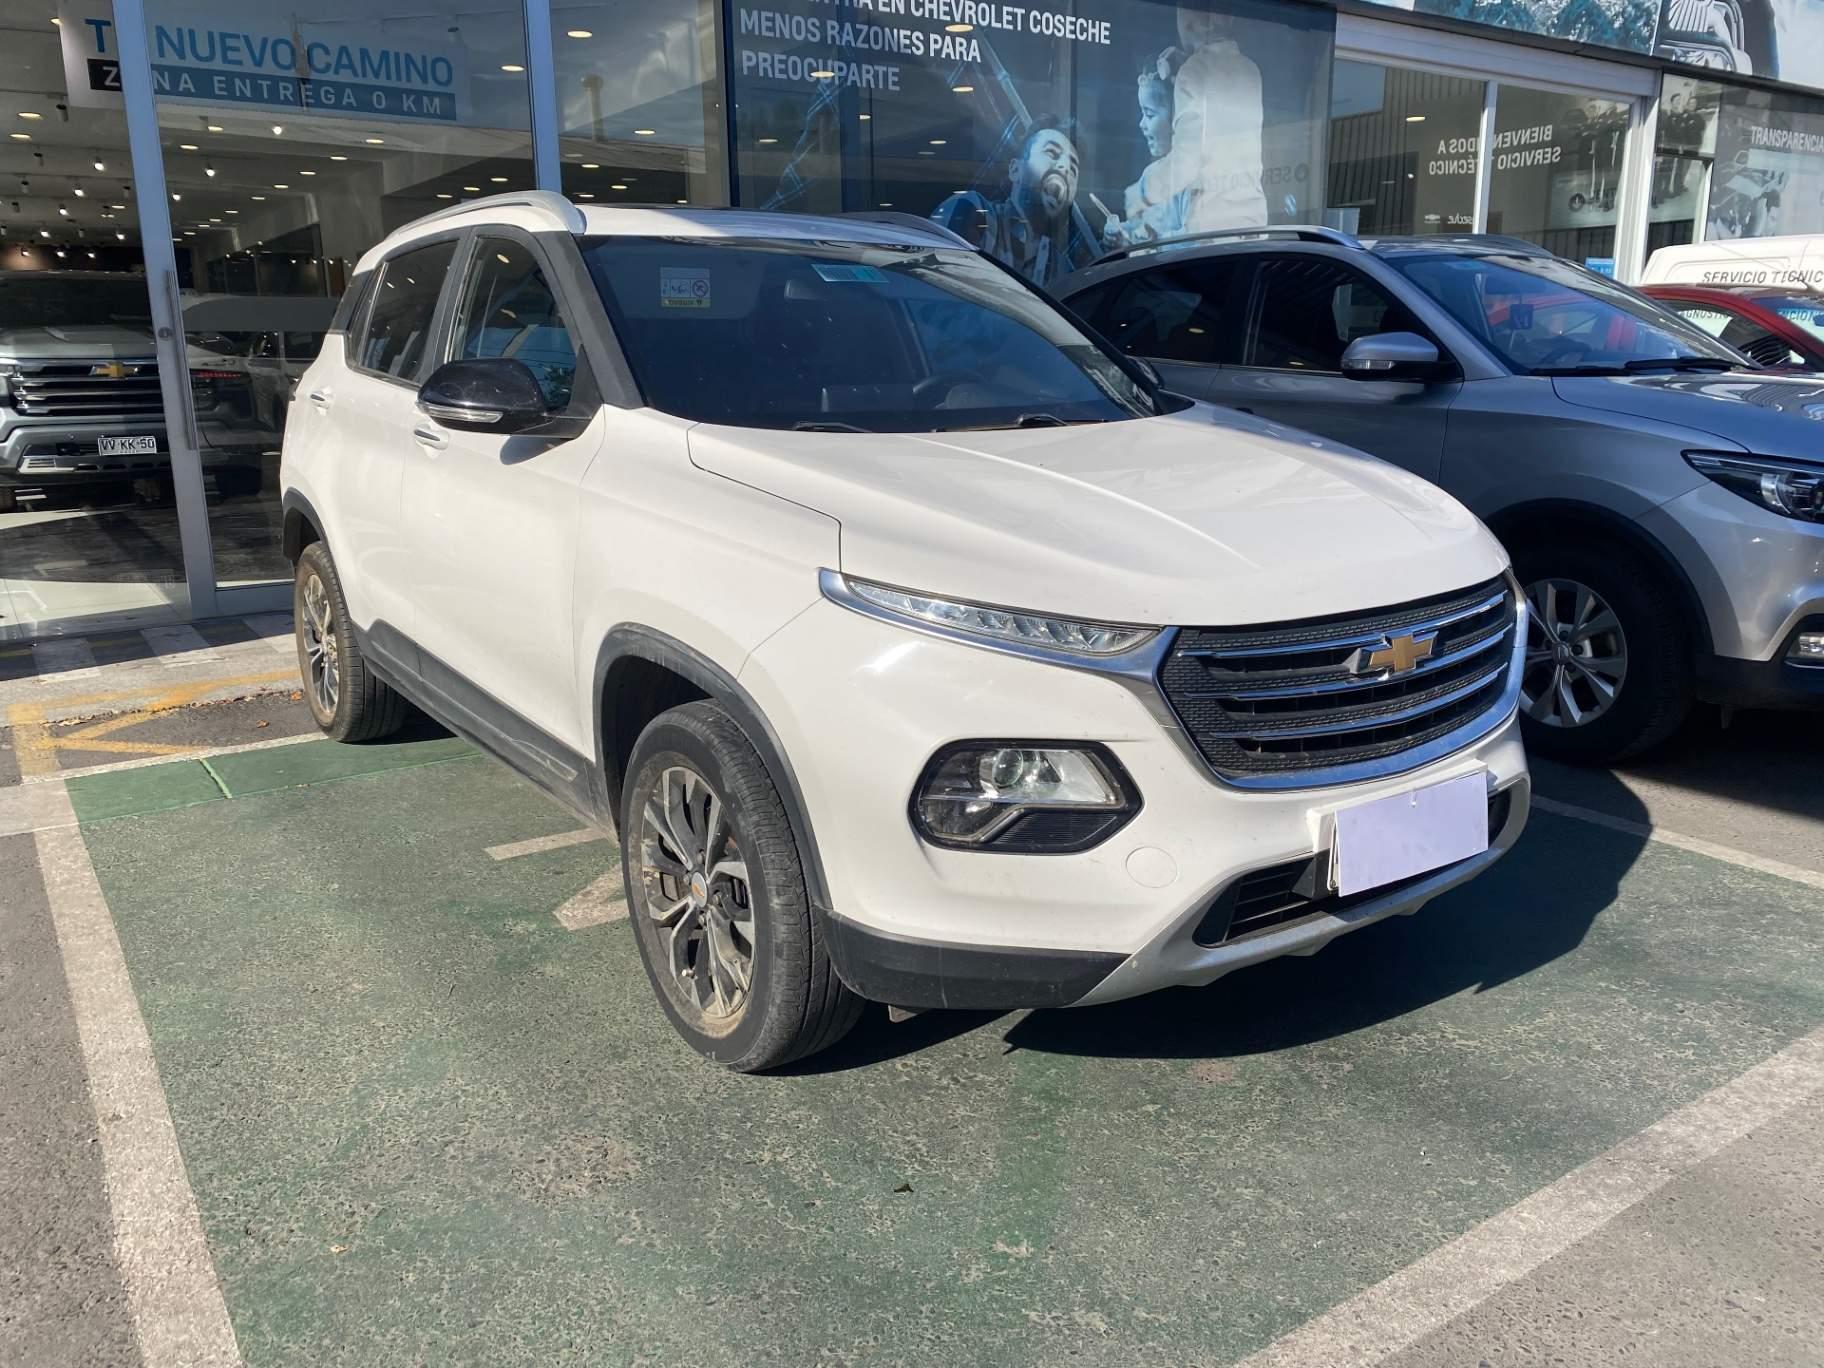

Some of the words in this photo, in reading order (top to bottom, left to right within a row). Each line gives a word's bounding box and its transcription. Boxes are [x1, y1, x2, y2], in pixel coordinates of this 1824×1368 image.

[740, 9, 820, 43] MENOS
[827, 25, 925, 55] RAZONES
[929, 34, 981, 63] PARA
[911, 0, 1025, 33] CHEVROLET
[1029, 10, 1111, 44] COSECHE
[155, 25, 297, 71] NUEVO
[306, 42, 454, 87] CAMINO
[741, 51, 900, 92] PREOCUPARTE
[102, 66, 196, 93] ZNA
[213, 76, 357, 107] ENTREGA
[402, 93, 441, 115] KM
[1703, 271, 1768, 284] SERVICIO
